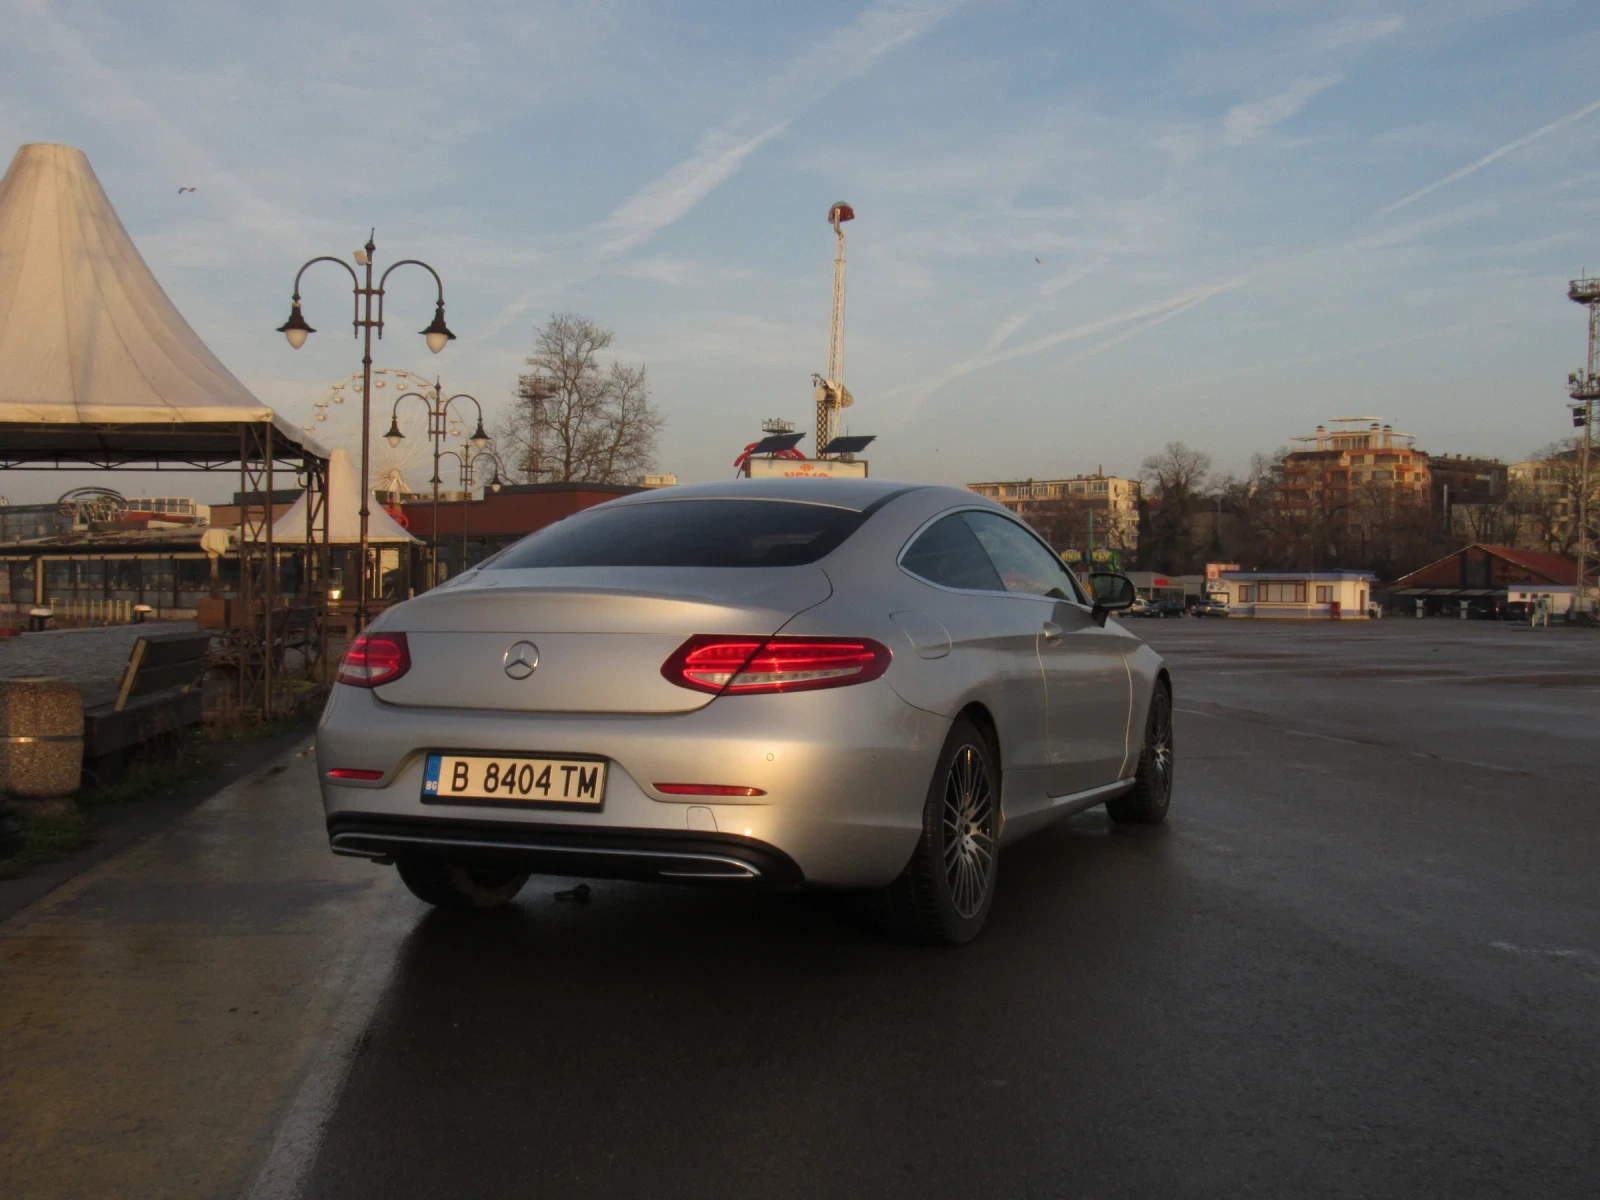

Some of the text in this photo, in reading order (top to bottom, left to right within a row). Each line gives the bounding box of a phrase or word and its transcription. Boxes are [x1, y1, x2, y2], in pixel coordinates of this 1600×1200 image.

[425, 780, 438, 790] BG
[451, 761, 598, 799] B 8404 TM
